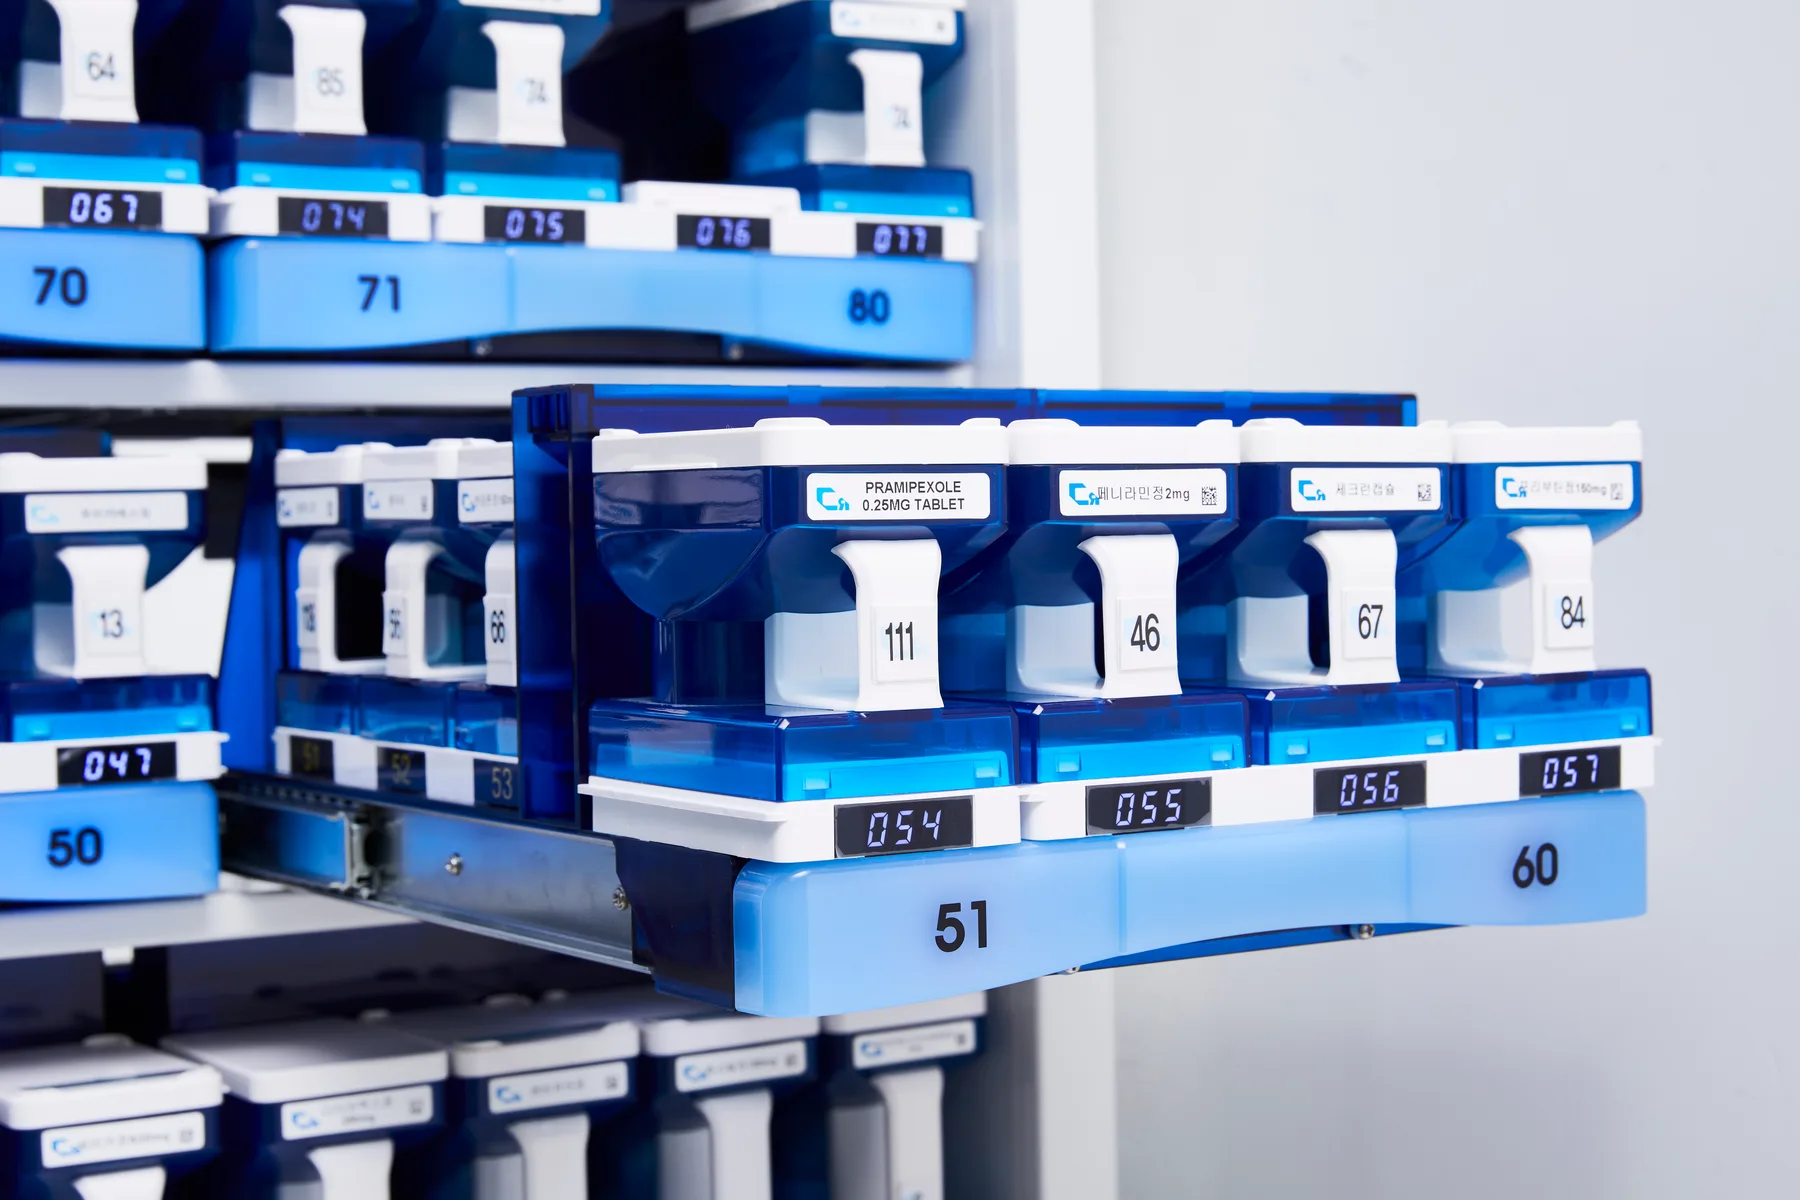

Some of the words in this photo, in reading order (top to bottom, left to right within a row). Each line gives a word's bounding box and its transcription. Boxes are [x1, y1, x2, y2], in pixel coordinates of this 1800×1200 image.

[87, 52, 115, 81] 64
[316, 67, 345, 96] 85
[69, 192, 139, 224] 067
[302, 202, 366, 231] 074
[505, 209, 565, 240] 075
[695, 217, 751, 248] 076
[873, 226, 928, 254] 077
[33, 267, 88, 306] 70
[358, 275, 400, 312] 71
[849, 290, 889, 324] 80
[865, 481, 962, 494] PRAMIPEXOLE
[1097, 486, 1190, 502] 페니라민정2mg
[862, 498, 911, 512] 0.25MG
[914, 498, 965, 511] TABLET
[99, 609, 124, 639] 13
[490, 610, 506, 644] 66
[1358, 603, 1384, 640] 67
[1560, 595, 1587, 631] 84
[884, 621, 914, 662] 111
[1130, 613, 1161, 653] 46
[84, 748, 152, 782] 047
[391, 753, 412, 785] 52
[1543, 754, 1599, 790] 057
[491, 767, 513, 800] 53
[1340, 770, 1400, 807] 056
[1115, 788, 1182, 828] 055
[867, 809, 942, 849] 054
[48, 826, 103, 867] 50
[1512, 842, 1559, 889] 60
[934, 899, 988, 953] 51
